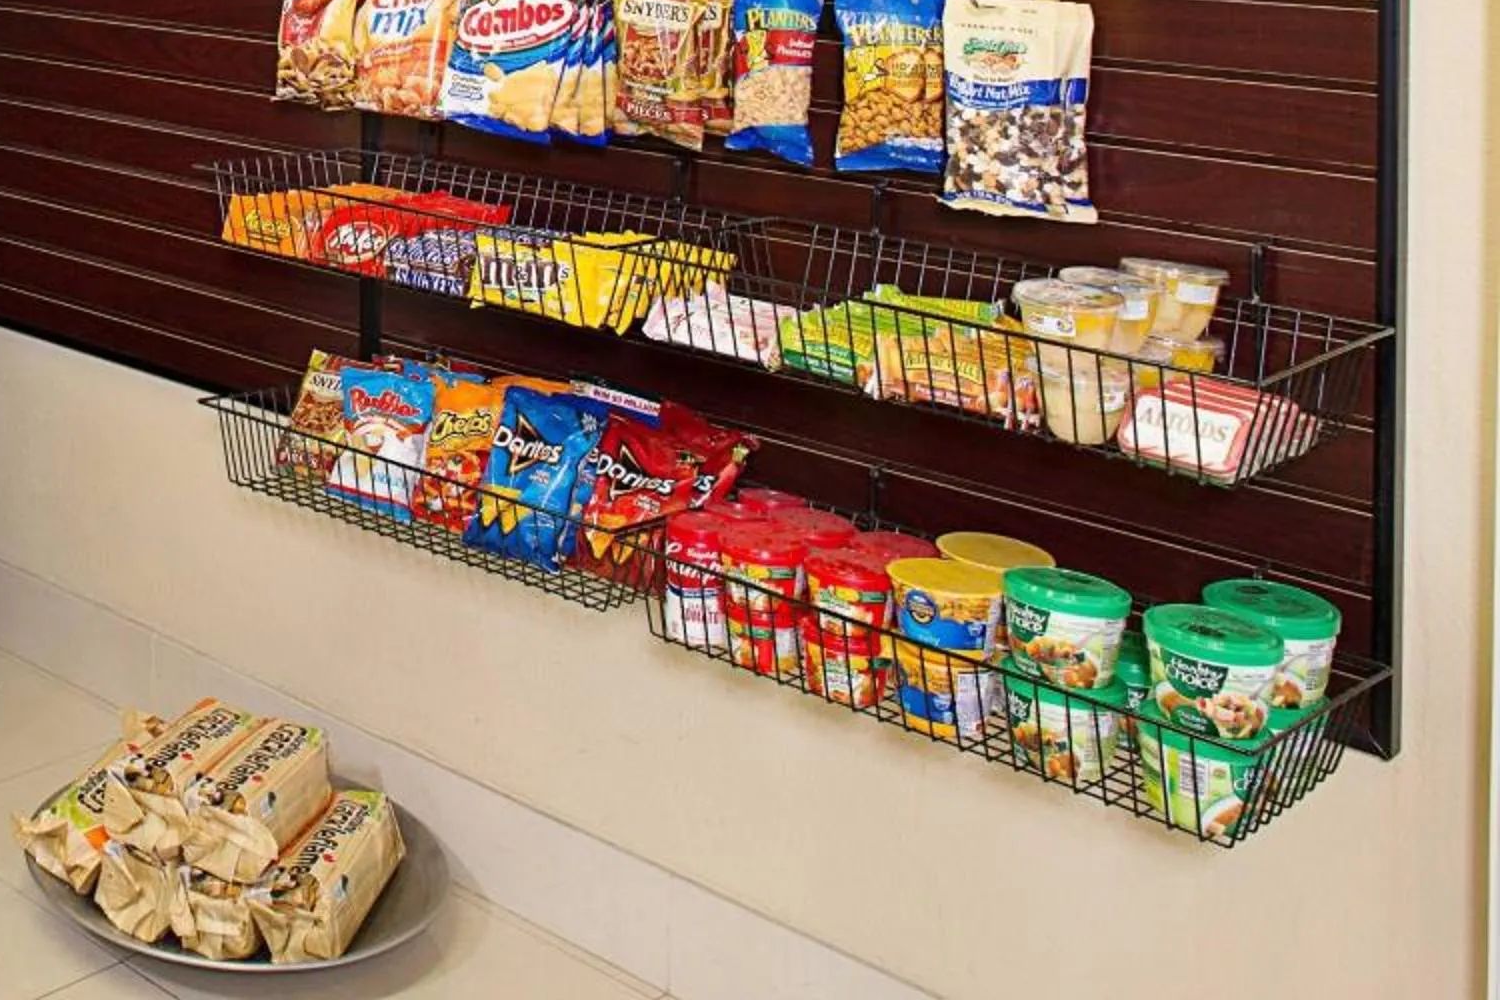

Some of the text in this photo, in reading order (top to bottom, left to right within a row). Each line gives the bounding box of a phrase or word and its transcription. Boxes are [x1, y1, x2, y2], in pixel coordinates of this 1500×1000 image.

[463, 0, 567, 38] Combos
[494, 425, 564, 464] Doritos
[596, 453, 677, 496] Doritos
